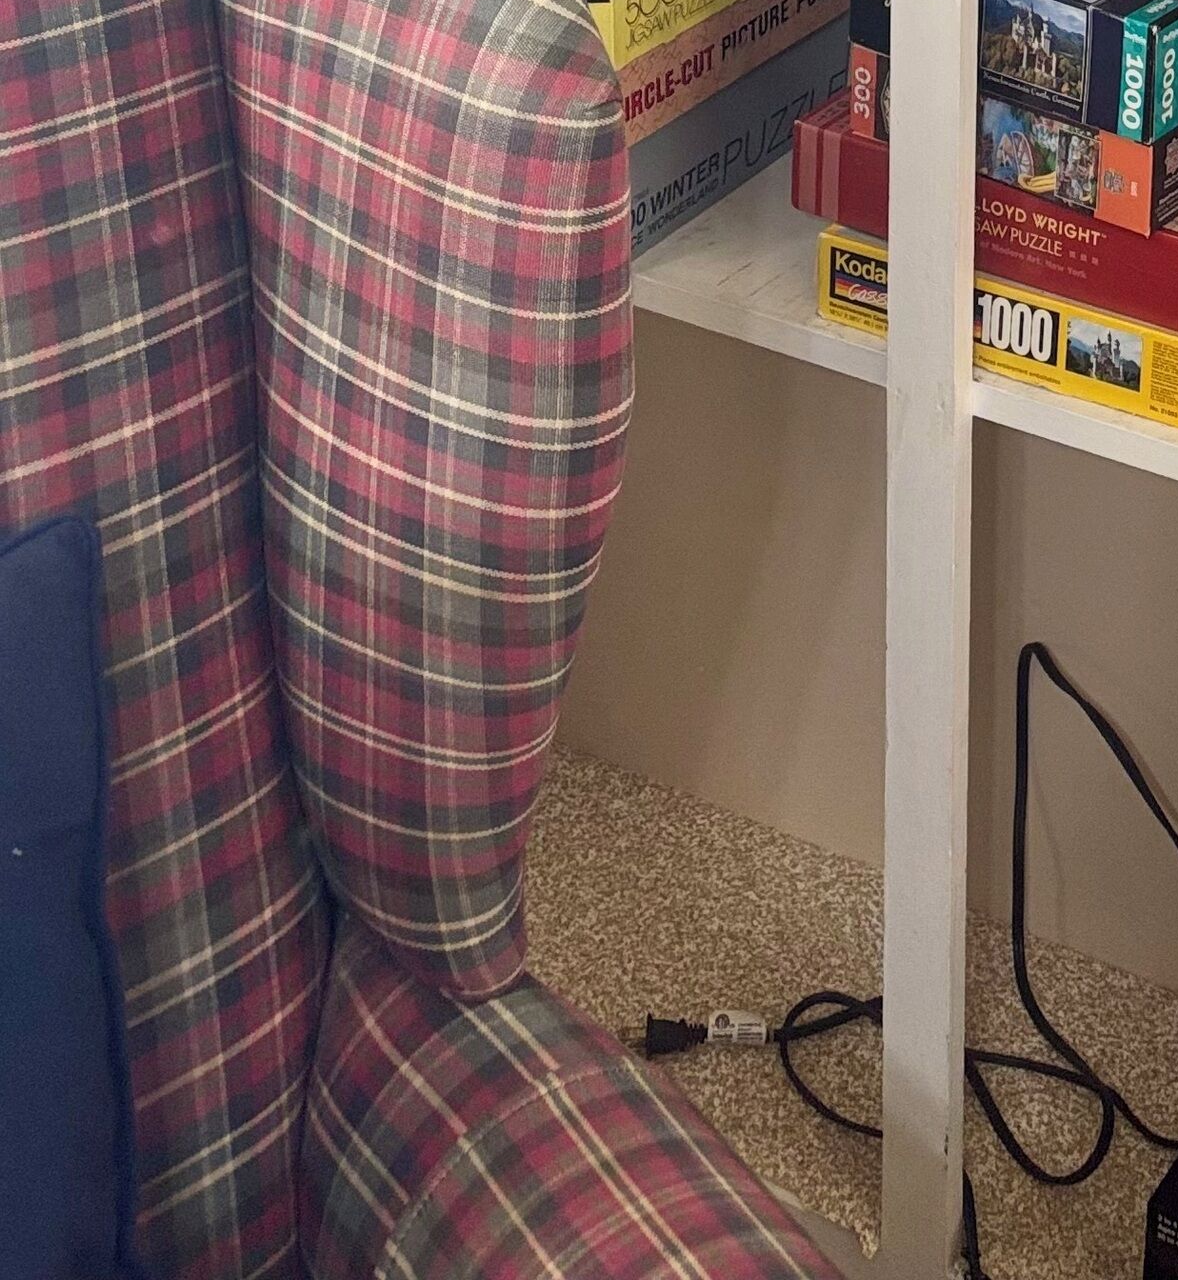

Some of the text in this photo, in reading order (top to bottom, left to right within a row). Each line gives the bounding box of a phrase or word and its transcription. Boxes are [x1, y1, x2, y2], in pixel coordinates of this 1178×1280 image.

[624, 44, 715, 122] IRCLE-CUT
[853, 65, 872, 120] 300
[1121, 53, 1144, 130] 1000
[1161, 47, 1176, 126] 1000
[651, 152, 721, 215] WINTER
[973, 197, 1102, 248] LOYD WRIGHT
[1009, 226, 1063, 258] PUZZLE
[834, 250, 888, 282] Koda
[978, 289, 1053, 363] 1000
